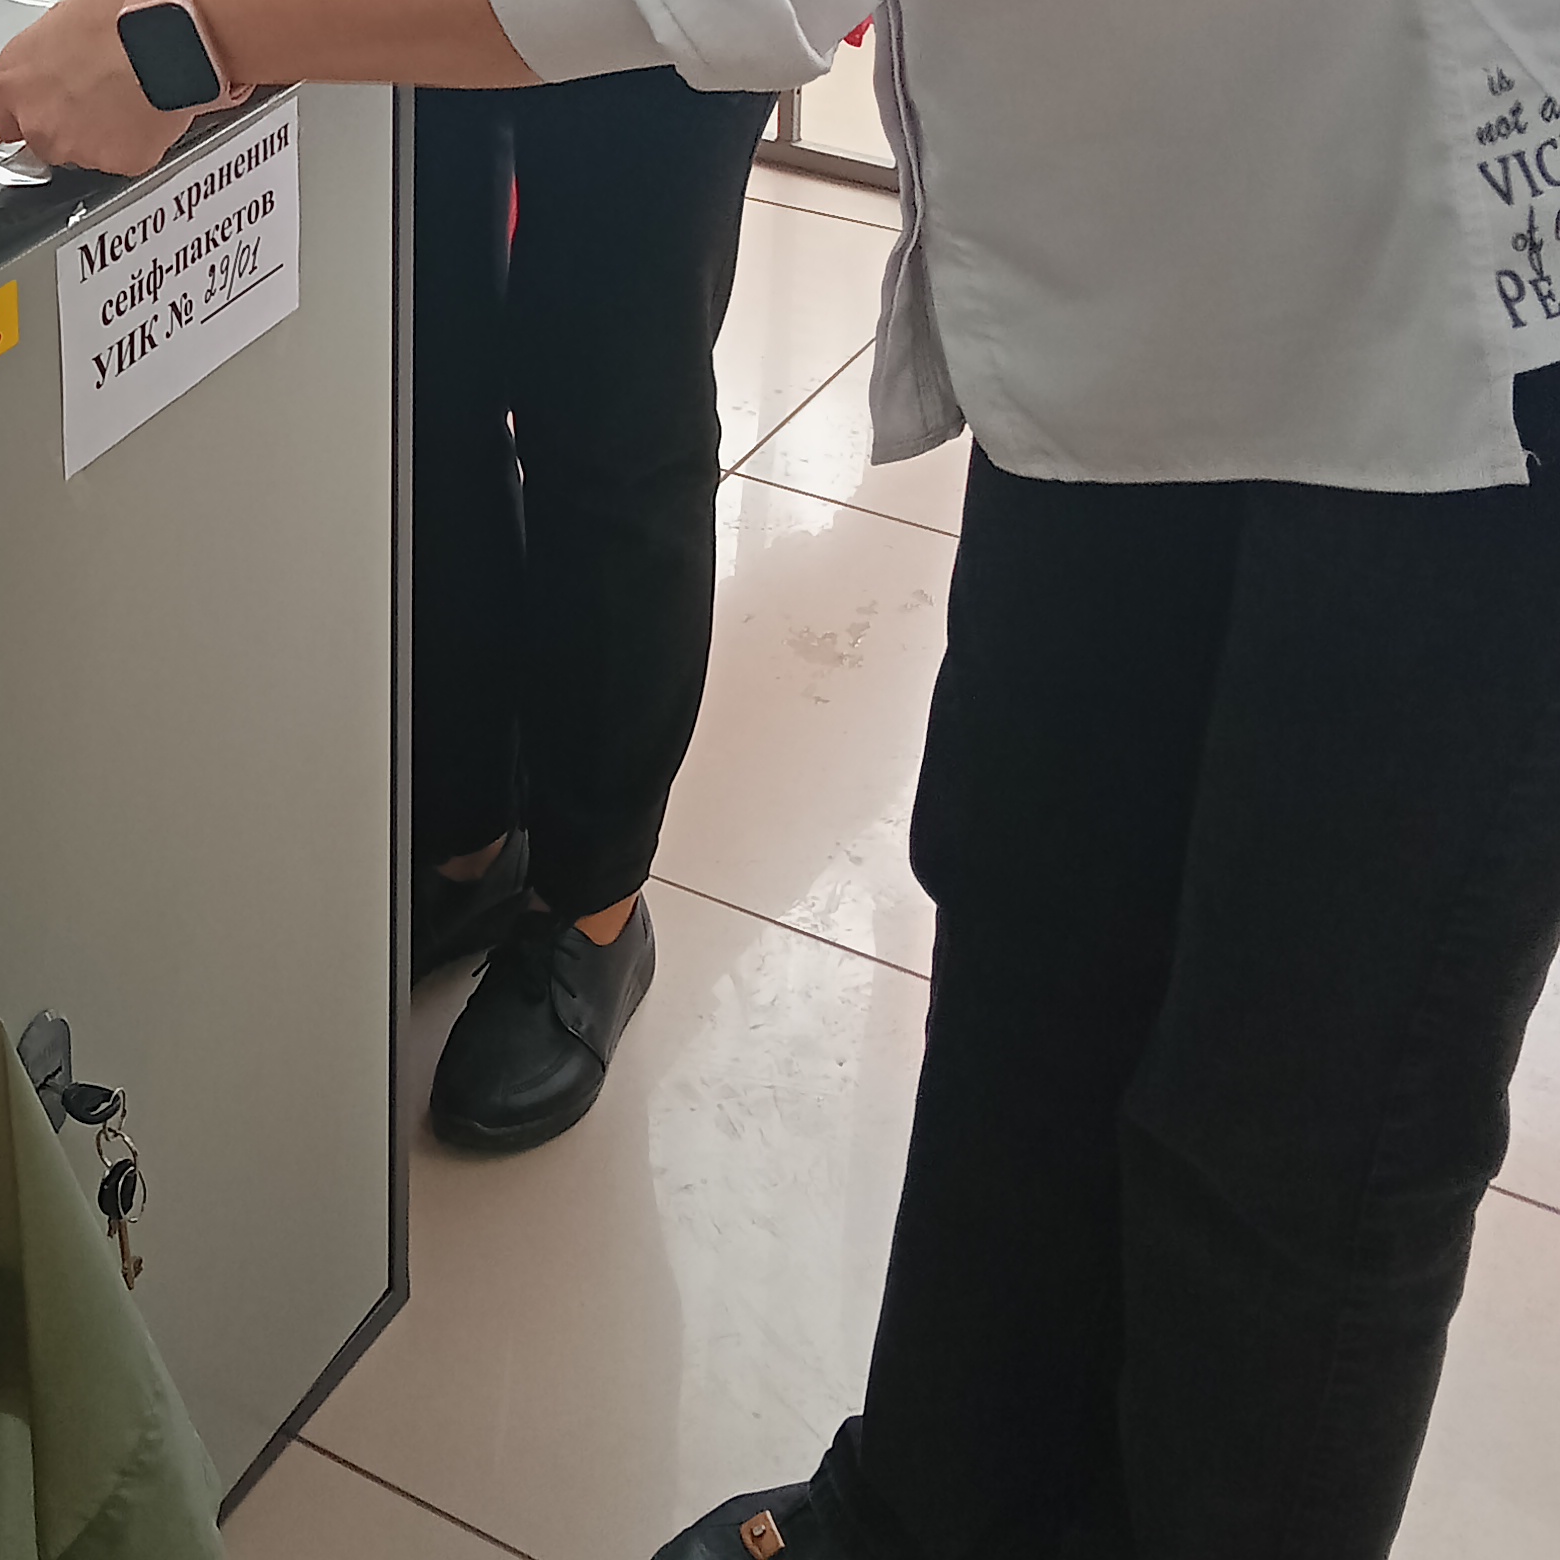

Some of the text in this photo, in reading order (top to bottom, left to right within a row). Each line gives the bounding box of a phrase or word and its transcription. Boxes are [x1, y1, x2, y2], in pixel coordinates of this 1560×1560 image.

[78, 122, 290, 284] Место хранения
[1477, 134, 1560, 207] VIC
[91, 236, 261, 391] УИК № 29/01
[100, 188, 276, 327] сейф-пакетов
